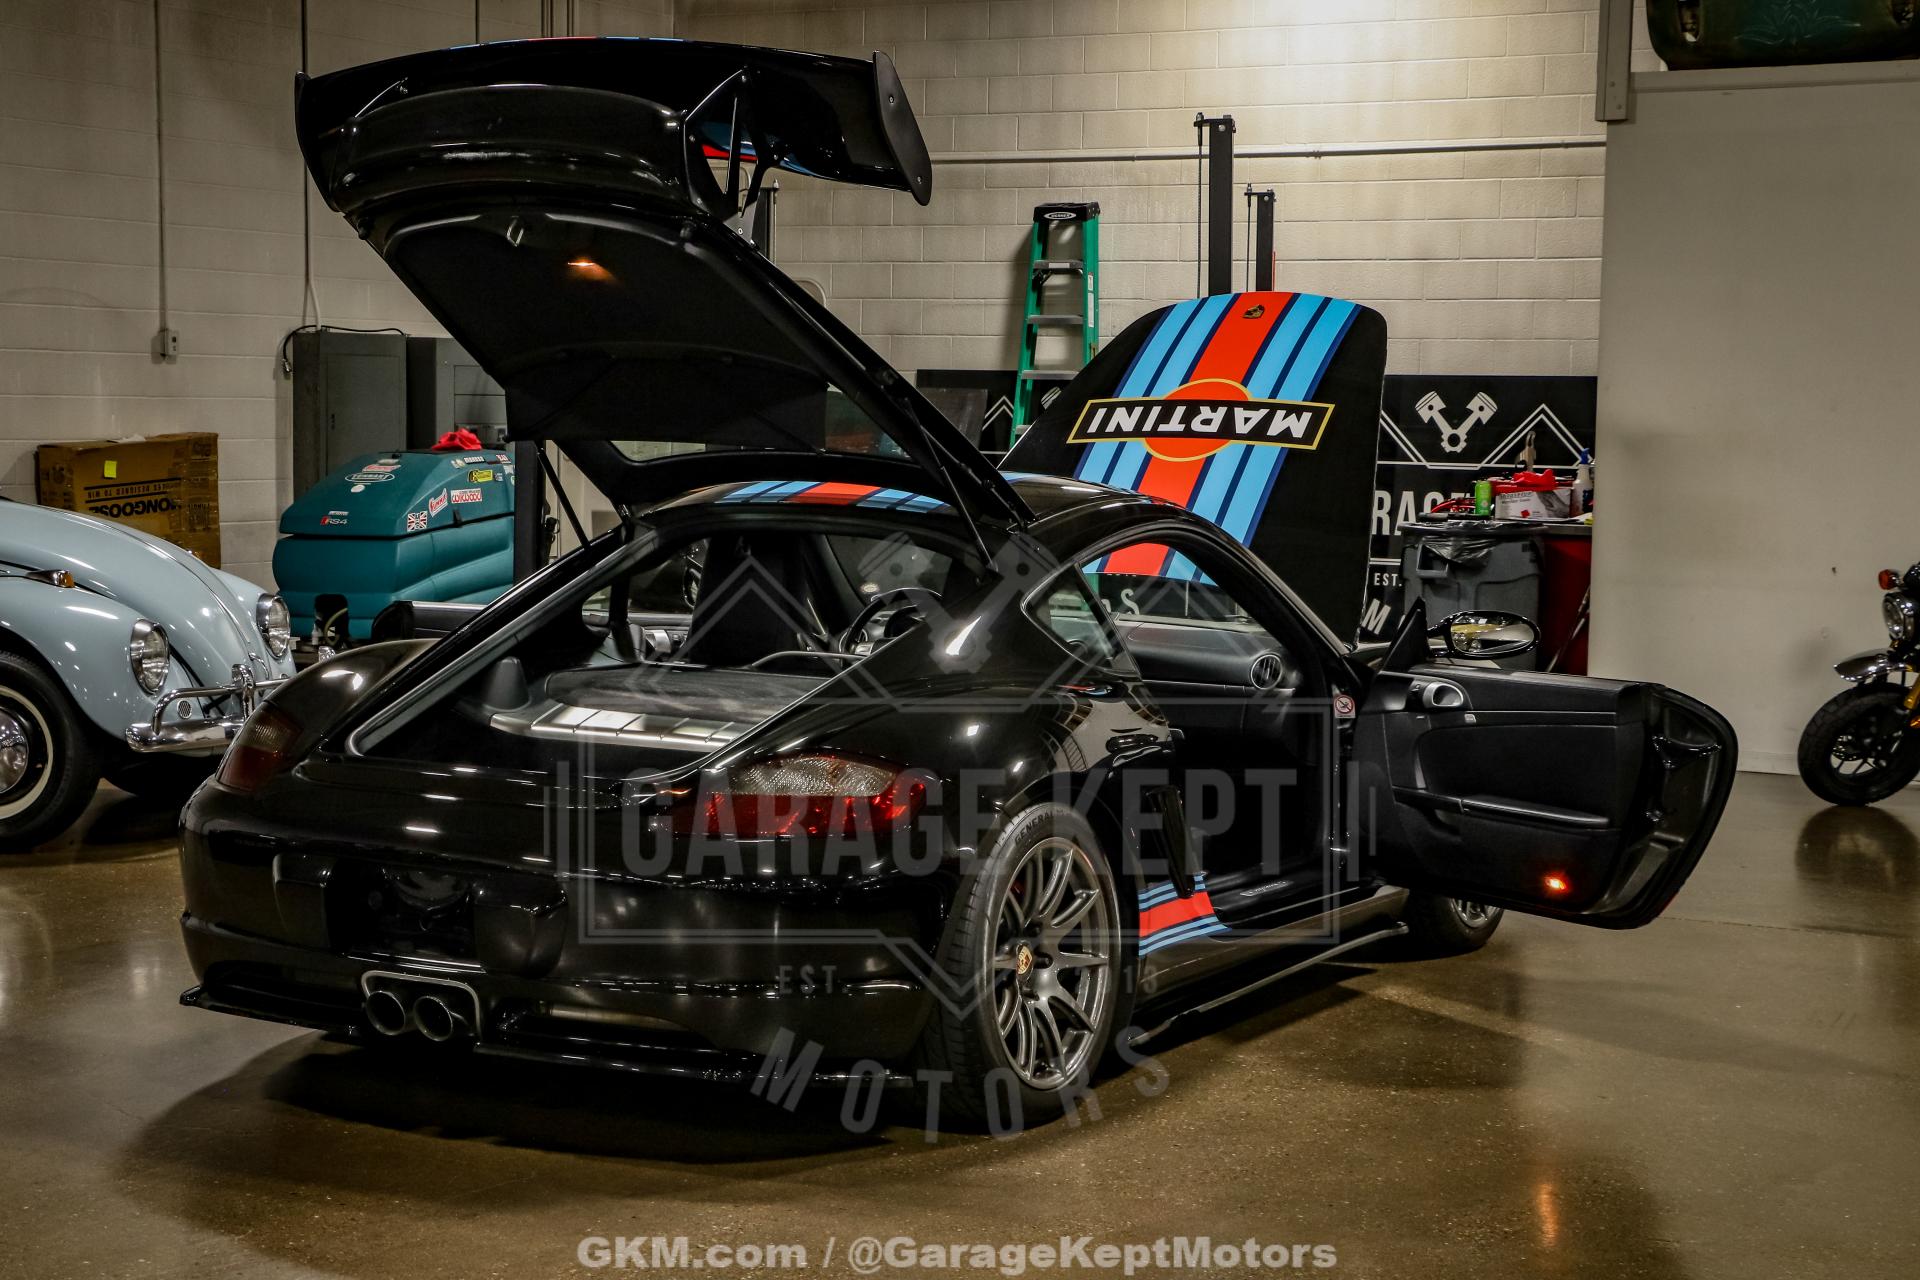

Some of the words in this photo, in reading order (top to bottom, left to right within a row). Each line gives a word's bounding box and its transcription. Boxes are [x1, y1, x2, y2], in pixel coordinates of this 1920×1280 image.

[1087, 406, 1312, 438] MARTINI
[1374, 573, 1402, 587] EST.
[1015, 811, 1053, 845] GENERAL
